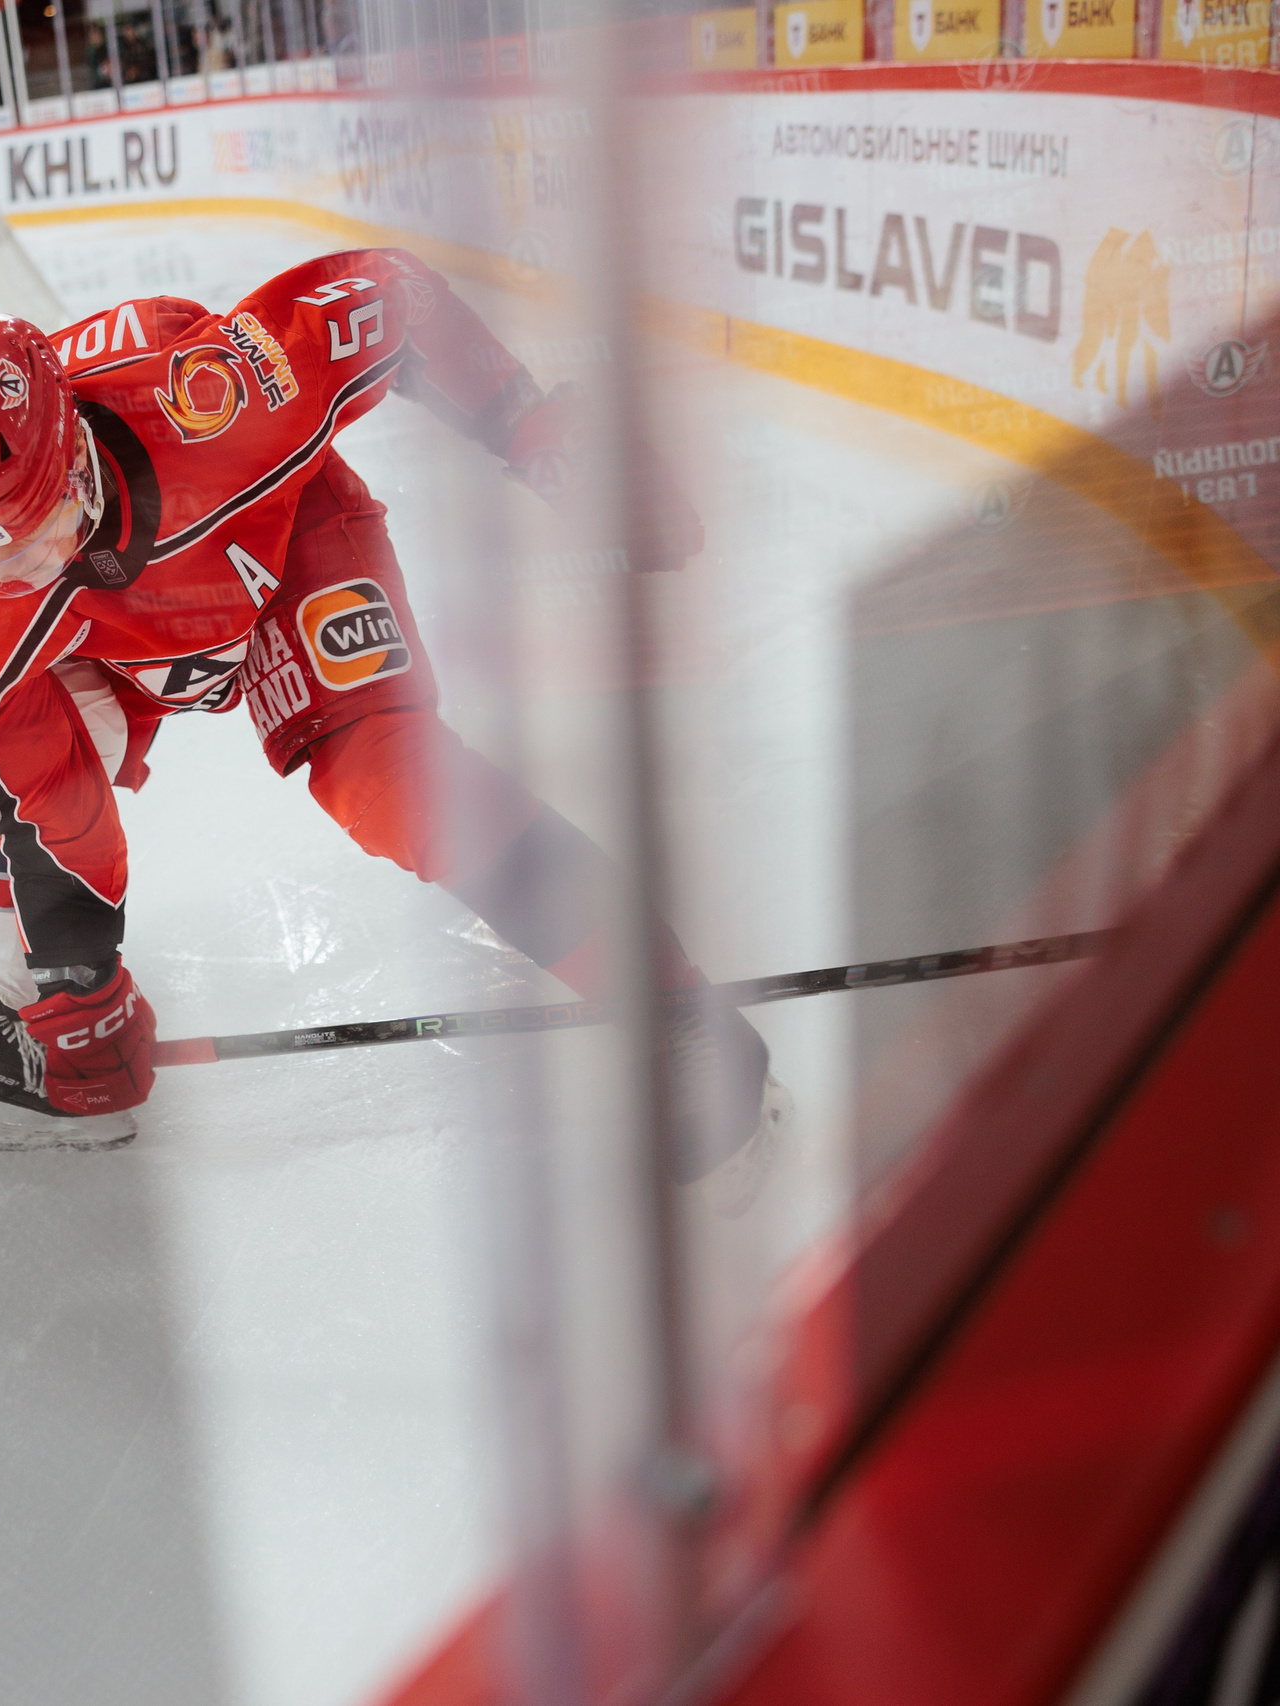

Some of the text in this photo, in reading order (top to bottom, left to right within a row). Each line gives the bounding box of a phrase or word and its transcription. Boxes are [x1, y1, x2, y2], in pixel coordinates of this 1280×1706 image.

[1067, 0, 1115, 27] БАНК
[8, 125, 177, 201] KHL.RU
[773, 123, 1069, 178] АВТОМОБИЛЬНЫЕ ШИНЫ
[733, 196, 1062, 344] GISLAVED
[248, 661, 312, 742] AND
